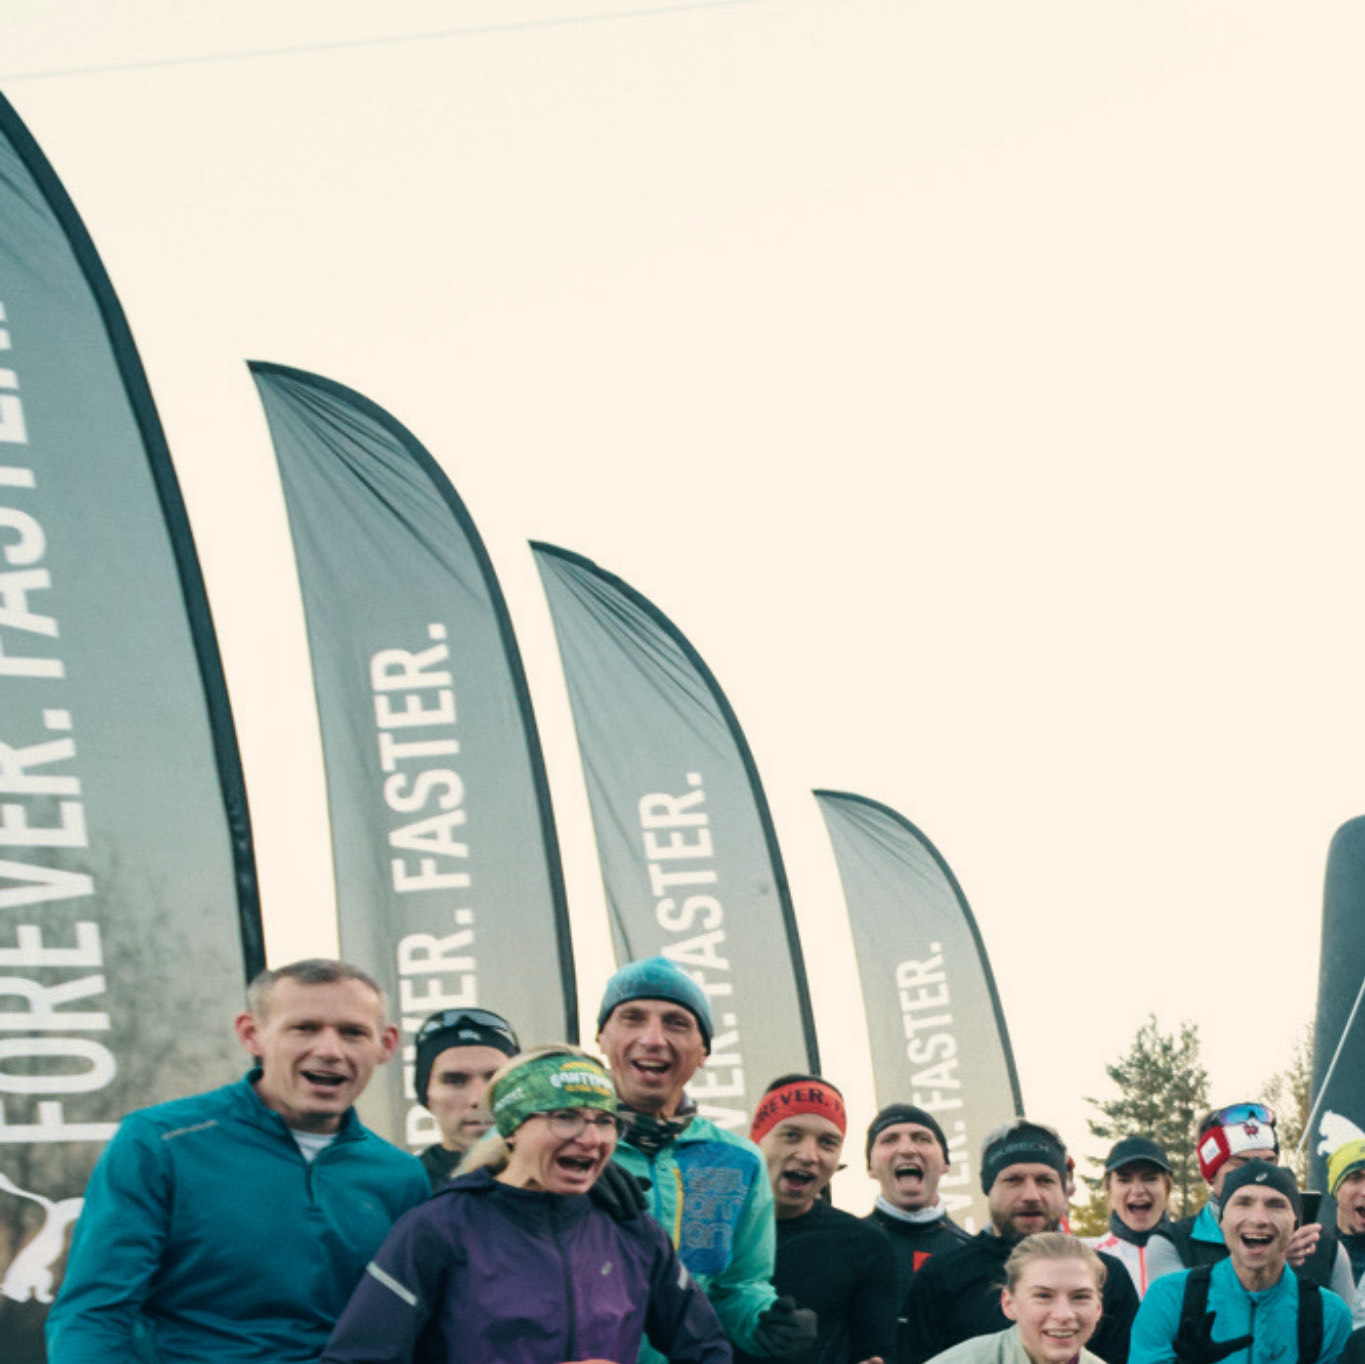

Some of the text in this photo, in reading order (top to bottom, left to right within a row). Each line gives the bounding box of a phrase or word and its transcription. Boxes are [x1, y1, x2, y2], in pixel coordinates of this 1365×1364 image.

[370, 623, 471, 892] FASTER.
[638, 772, 734, 997] FASTER.
[896, 941, 964, 1120] FASTER.
